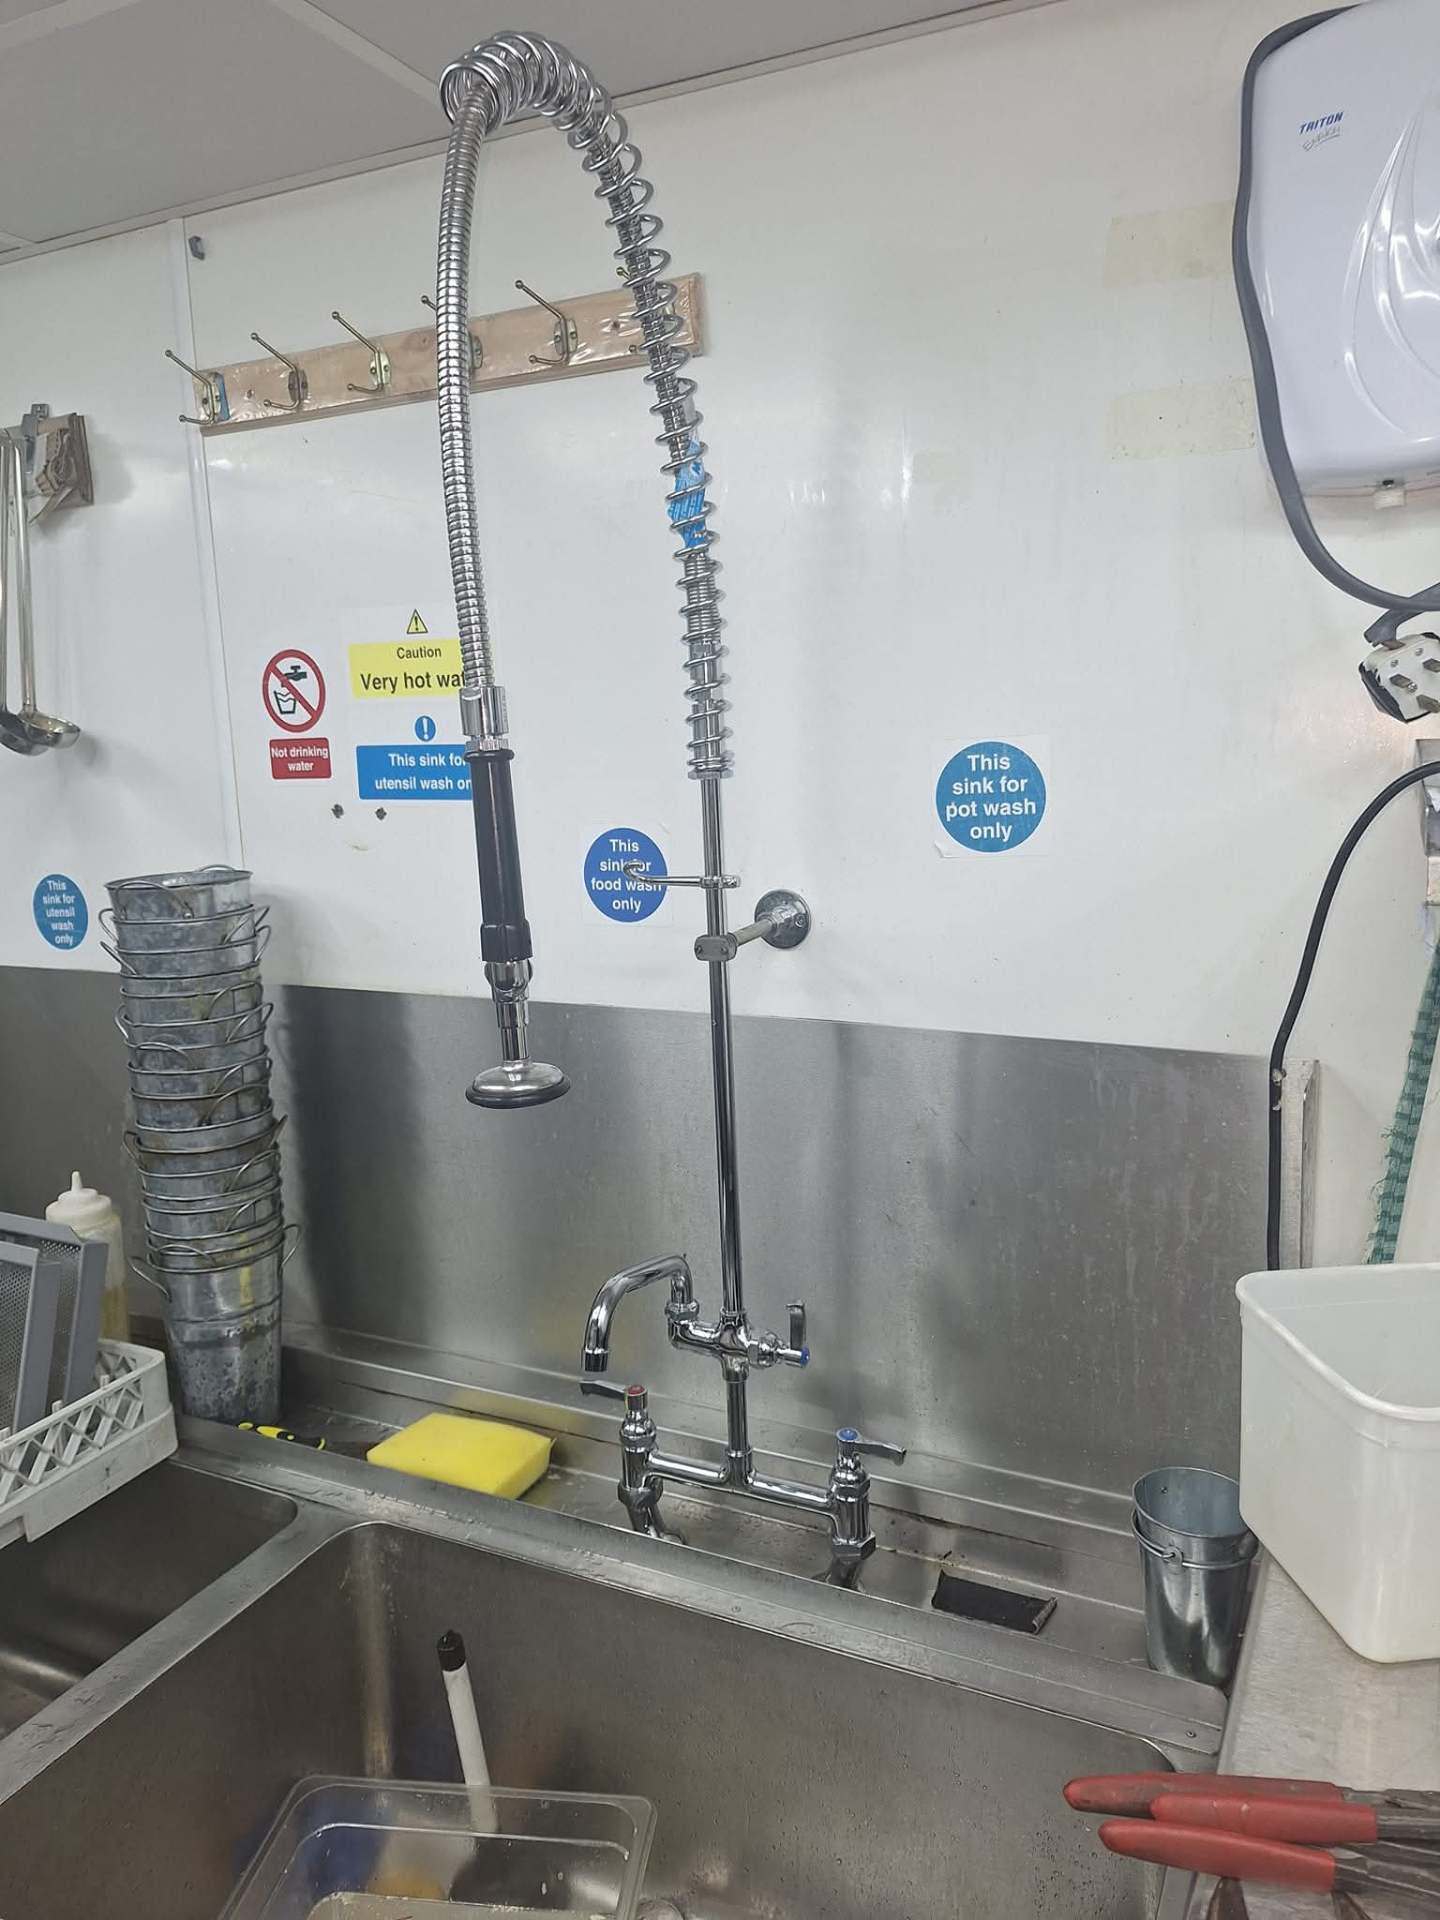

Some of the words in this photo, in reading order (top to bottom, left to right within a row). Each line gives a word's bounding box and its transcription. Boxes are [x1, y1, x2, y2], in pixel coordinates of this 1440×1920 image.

[1300, 111, 1344, 134] TRITON
[396, 646, 442, 660] Caution
[360, 673, 398, 694] Very
[403, 672, 432, 689] hot
[437, 672, 465, 688] wat
[271, 747, 288, 758] Not
[290, 746, 329, 759] drinking
[287, 761, 314, 771] water
[388, 753, 416, 767] This
[419, 753, 447, 767] sink
[967, 754, 1011, 772] This
[375, 777, 417, 790] utensil
[420, 776, 453, 790] wash
[952, 777, 994, 795] sink
[999, 776, 1028, 793] for
[946, 801, 978, 822] pot
[983, 798, 1036, 817] wash
[970, 822, 1012, 843] only
[609, 839, 640, 852] This
[632, 859, 651, 872] or
[47, 880, 67, 891] This
[591, 878, 621, 891] food
[42, 893, 62, 905] sink
[62, 893, 75, 904] for
[612, 897, 641, 914] only
[46, 907, 75, 918] utensil
[51, 920, 74, 930] wash
[54, 934, 73, 946] only
